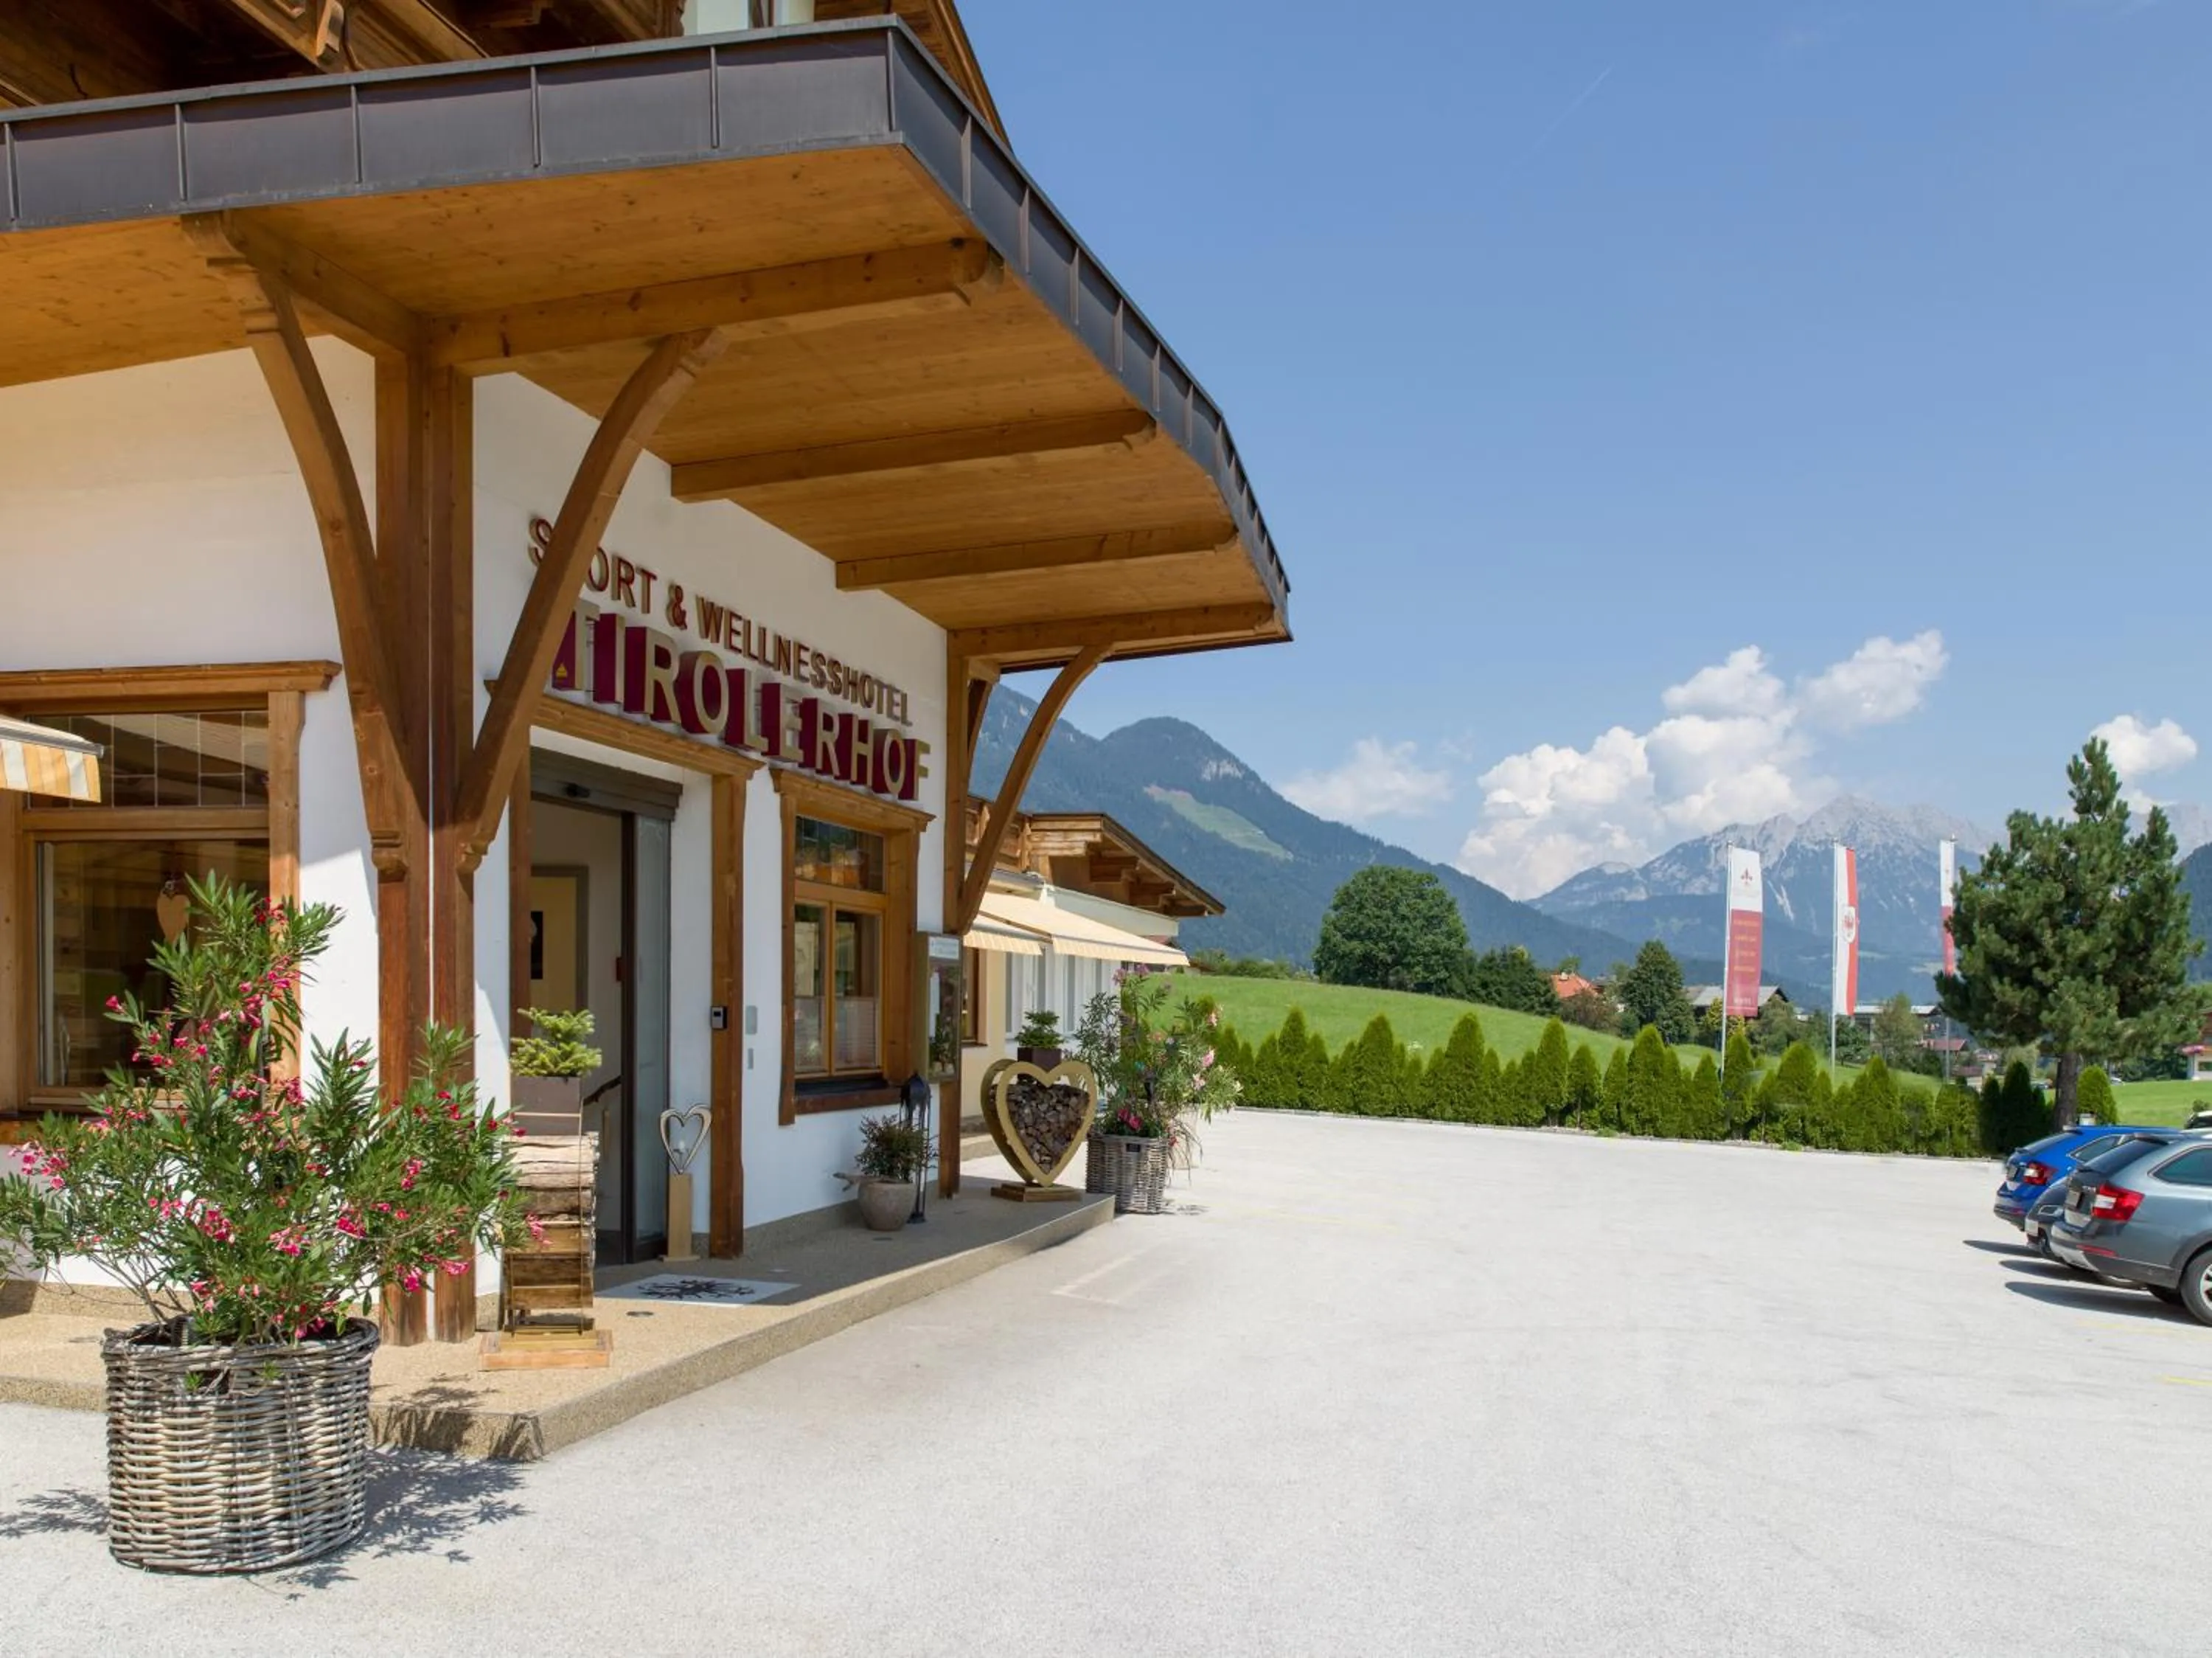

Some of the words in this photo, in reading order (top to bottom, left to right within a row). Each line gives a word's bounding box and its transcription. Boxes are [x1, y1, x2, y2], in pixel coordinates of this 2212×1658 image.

[529, 517, 658, 614] SORT
[666, 581, 687, 631] &
[696, 594, 913, 726] WELLNESSHOTEL
[552, 600, 931, 801] TIROLERHOF
